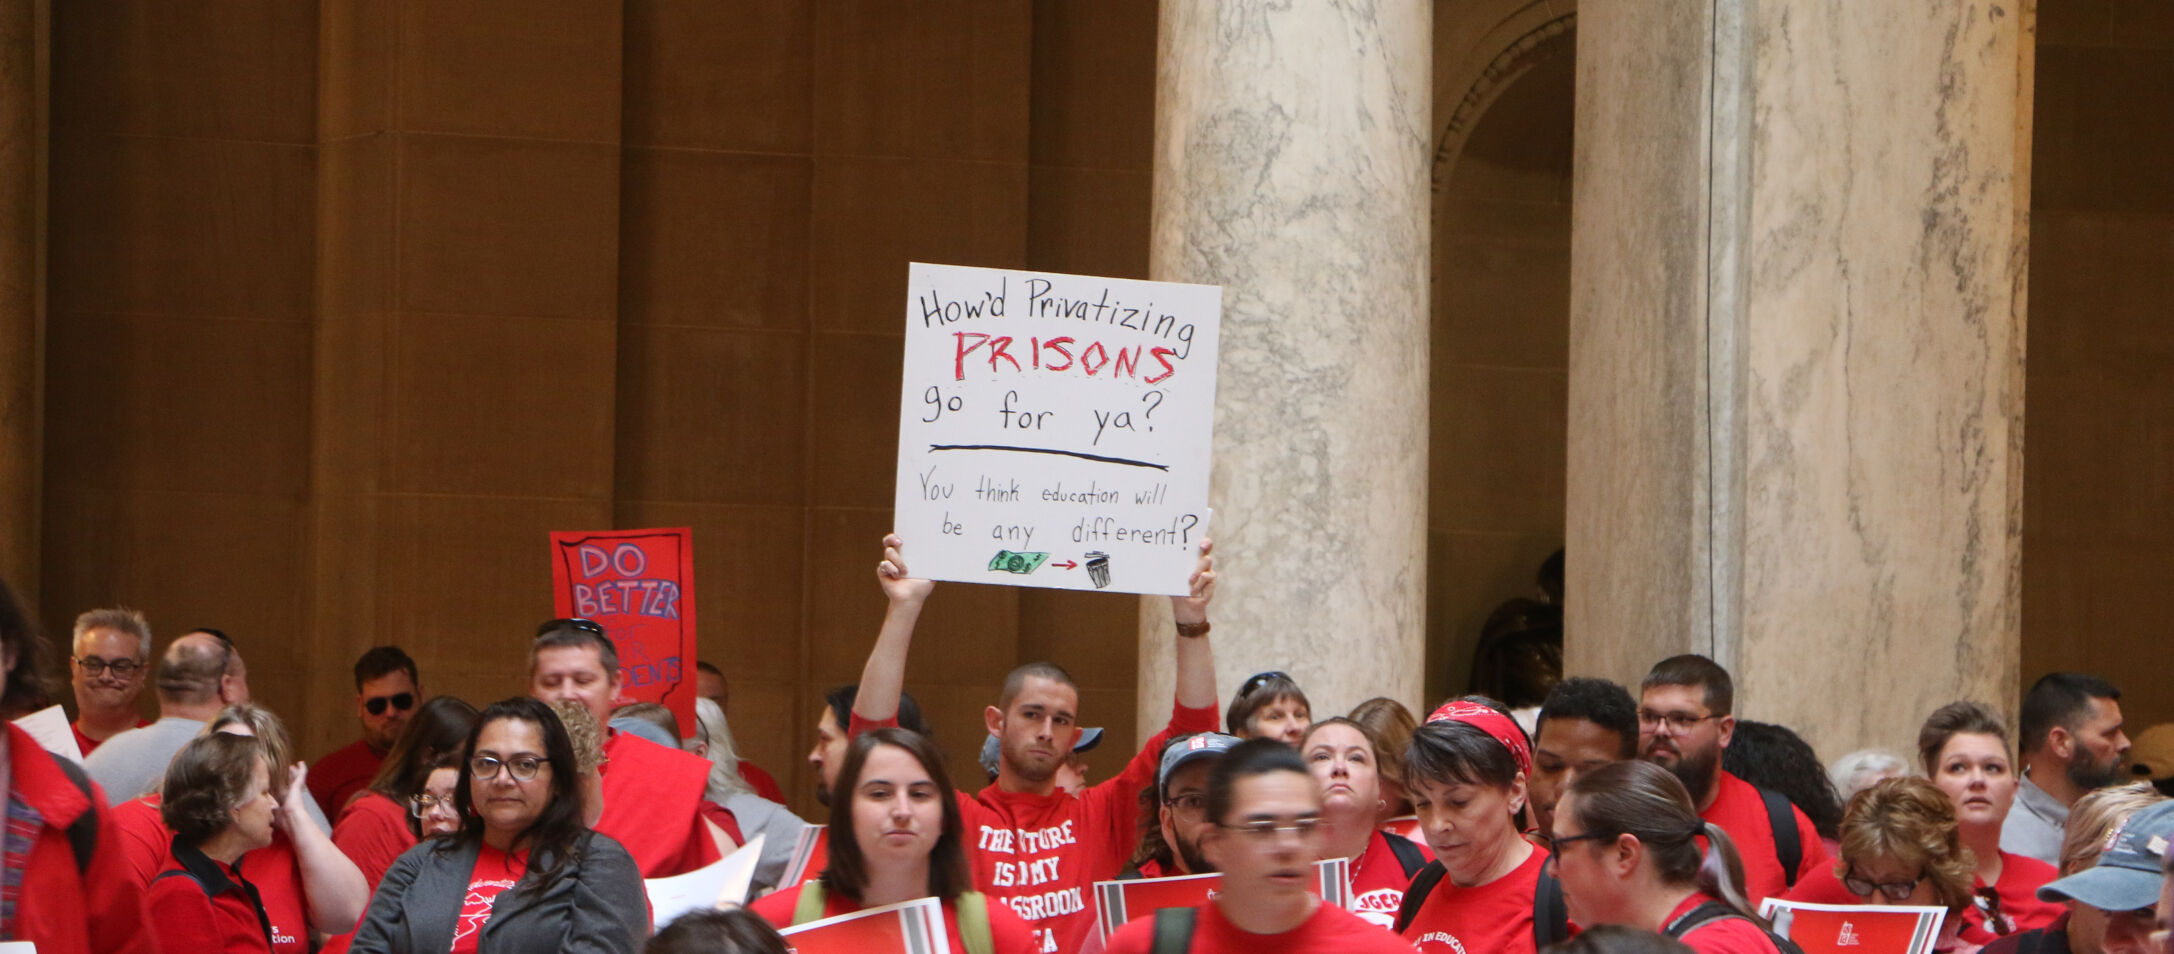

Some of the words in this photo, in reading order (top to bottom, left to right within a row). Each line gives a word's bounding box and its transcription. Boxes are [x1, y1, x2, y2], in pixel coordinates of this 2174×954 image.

[919, 276, 1007, 328] How'd
[1024, 278, 1196, 360] Privatizing
[952, 331, 1176, 385] PRISONS
[922, 385, 964, 423] go
[999, 390, 1054, 430] for
[1093, 390, 1164, 446] ya?
[920, 465, 955, 501] You
[975, 474, 1021, 502] think
[1042, 480, 1120, 504] education
[1135, 482, 1168, 506] will
[942, 511, 963, 536] be
[992, 523, 1035, 550] any
[1072, 513, 1199, 551] different?
[579, 543, 648, 578] DO
[575, 579, 681, 620] BETTER
[619, 657, 681, 688] DENTS
[978, 825, 1015, 855] THE
[992, 861, 1016, 887] IS
[1029, 856, 1060, 886] MY
